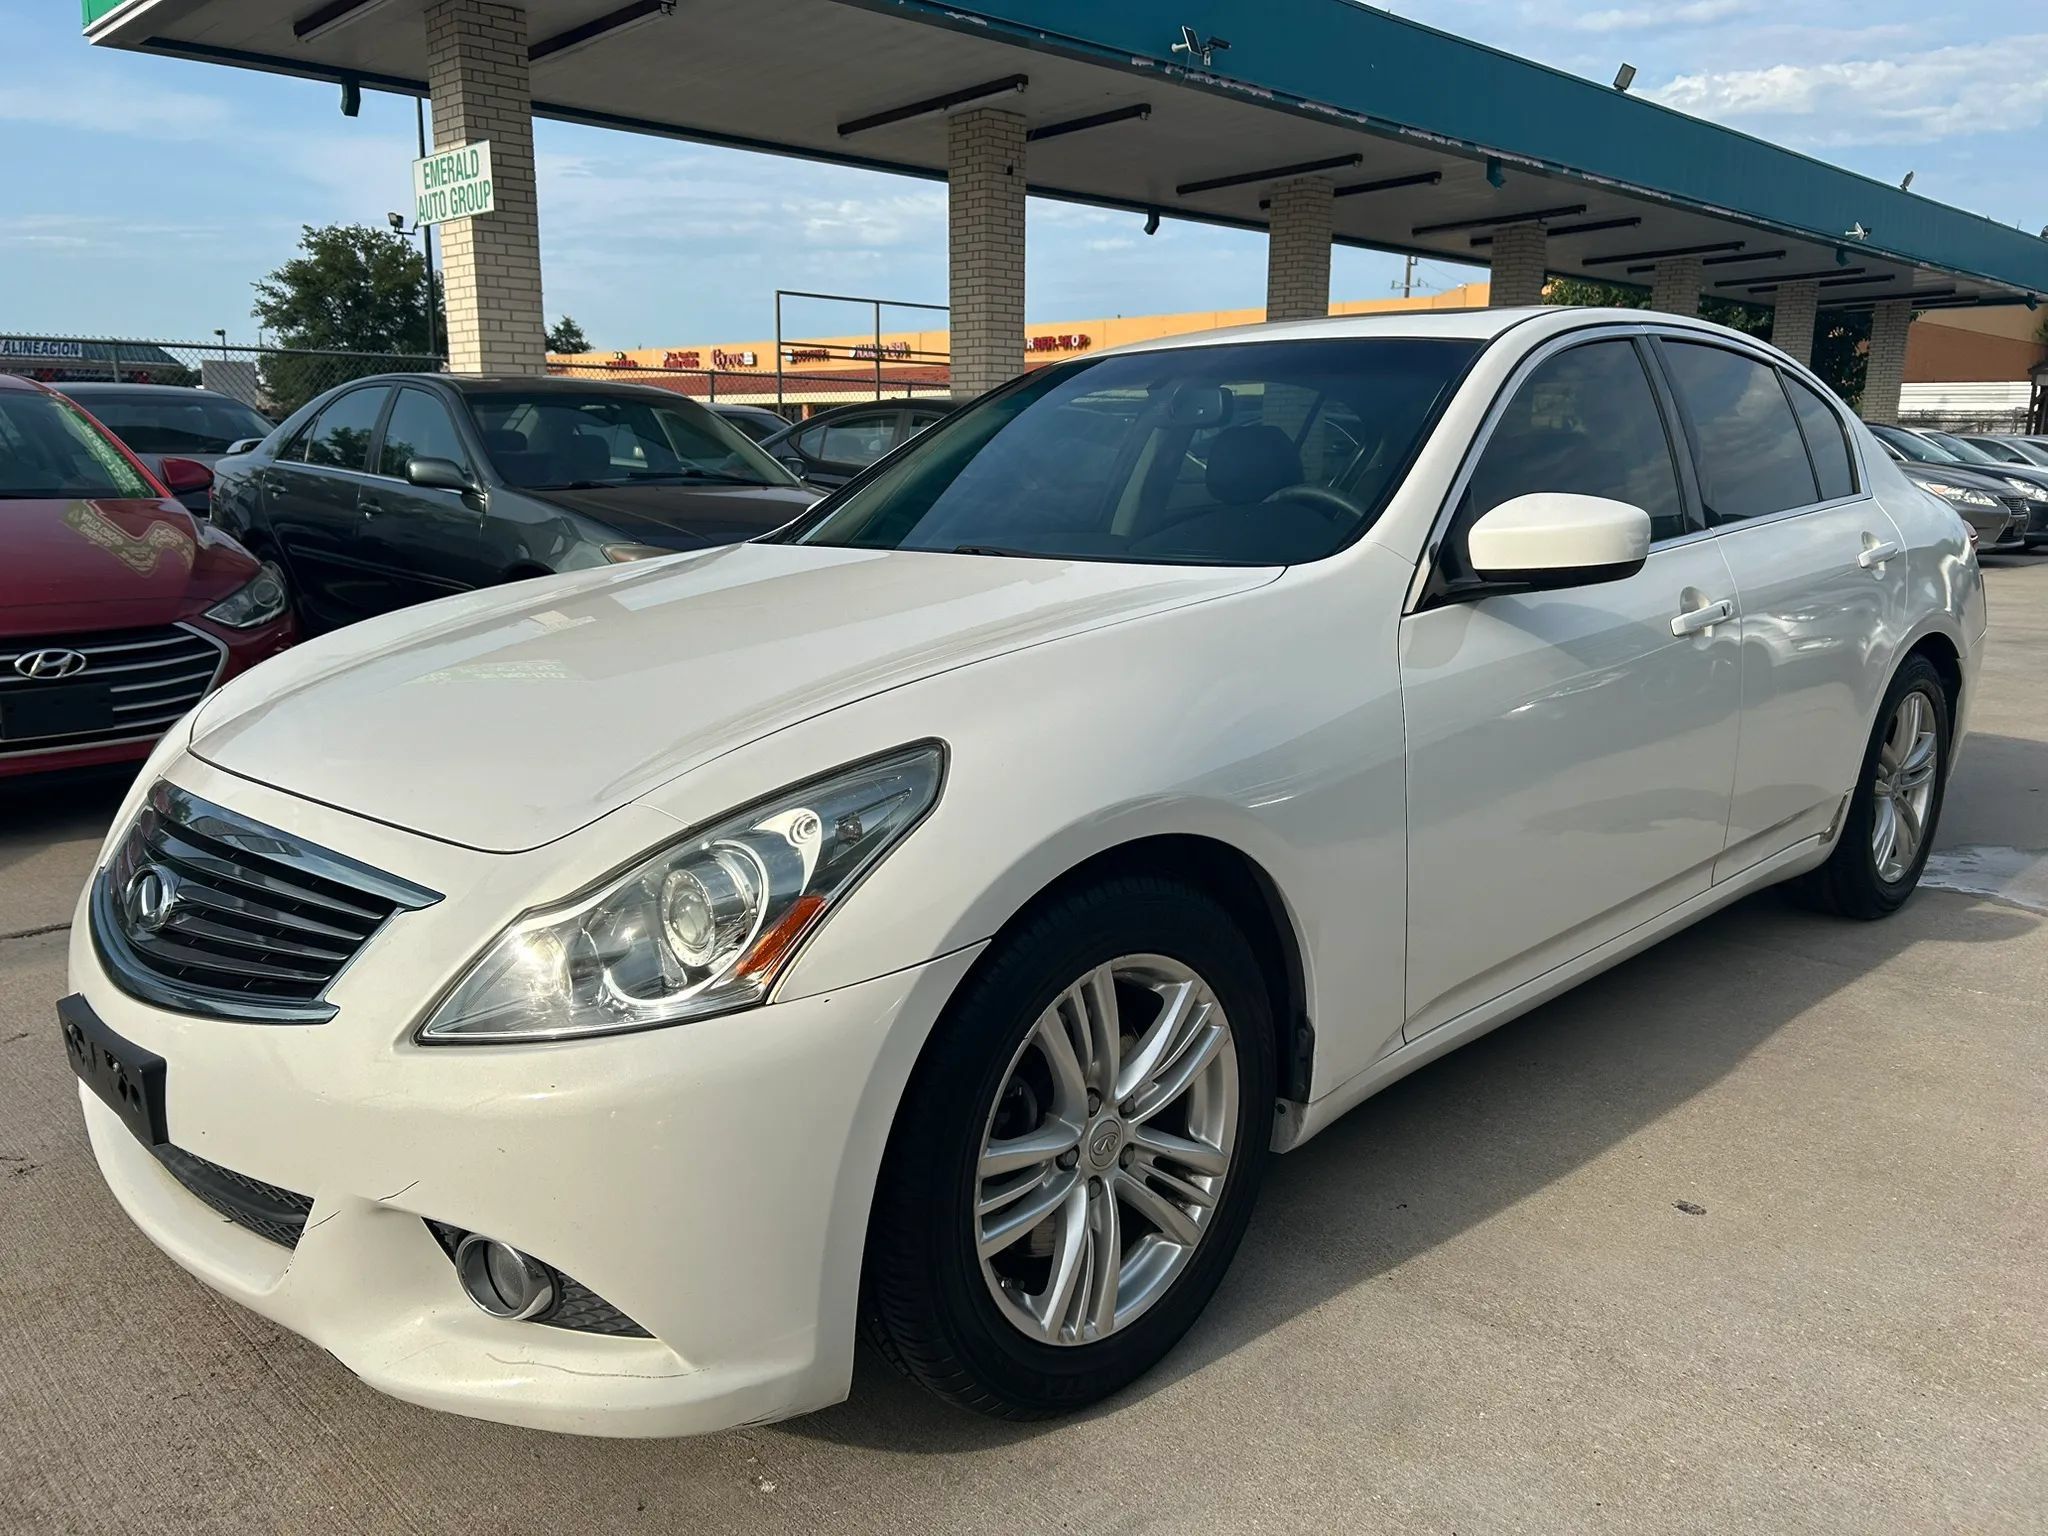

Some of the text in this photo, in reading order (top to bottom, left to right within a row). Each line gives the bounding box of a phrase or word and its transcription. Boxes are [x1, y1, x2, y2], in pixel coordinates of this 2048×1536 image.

[423, 149, 479, 190] EMERALD
[418, 180, 491, 223] AUTO GROUP
[3, 340, 79, 355] ALINEACION
